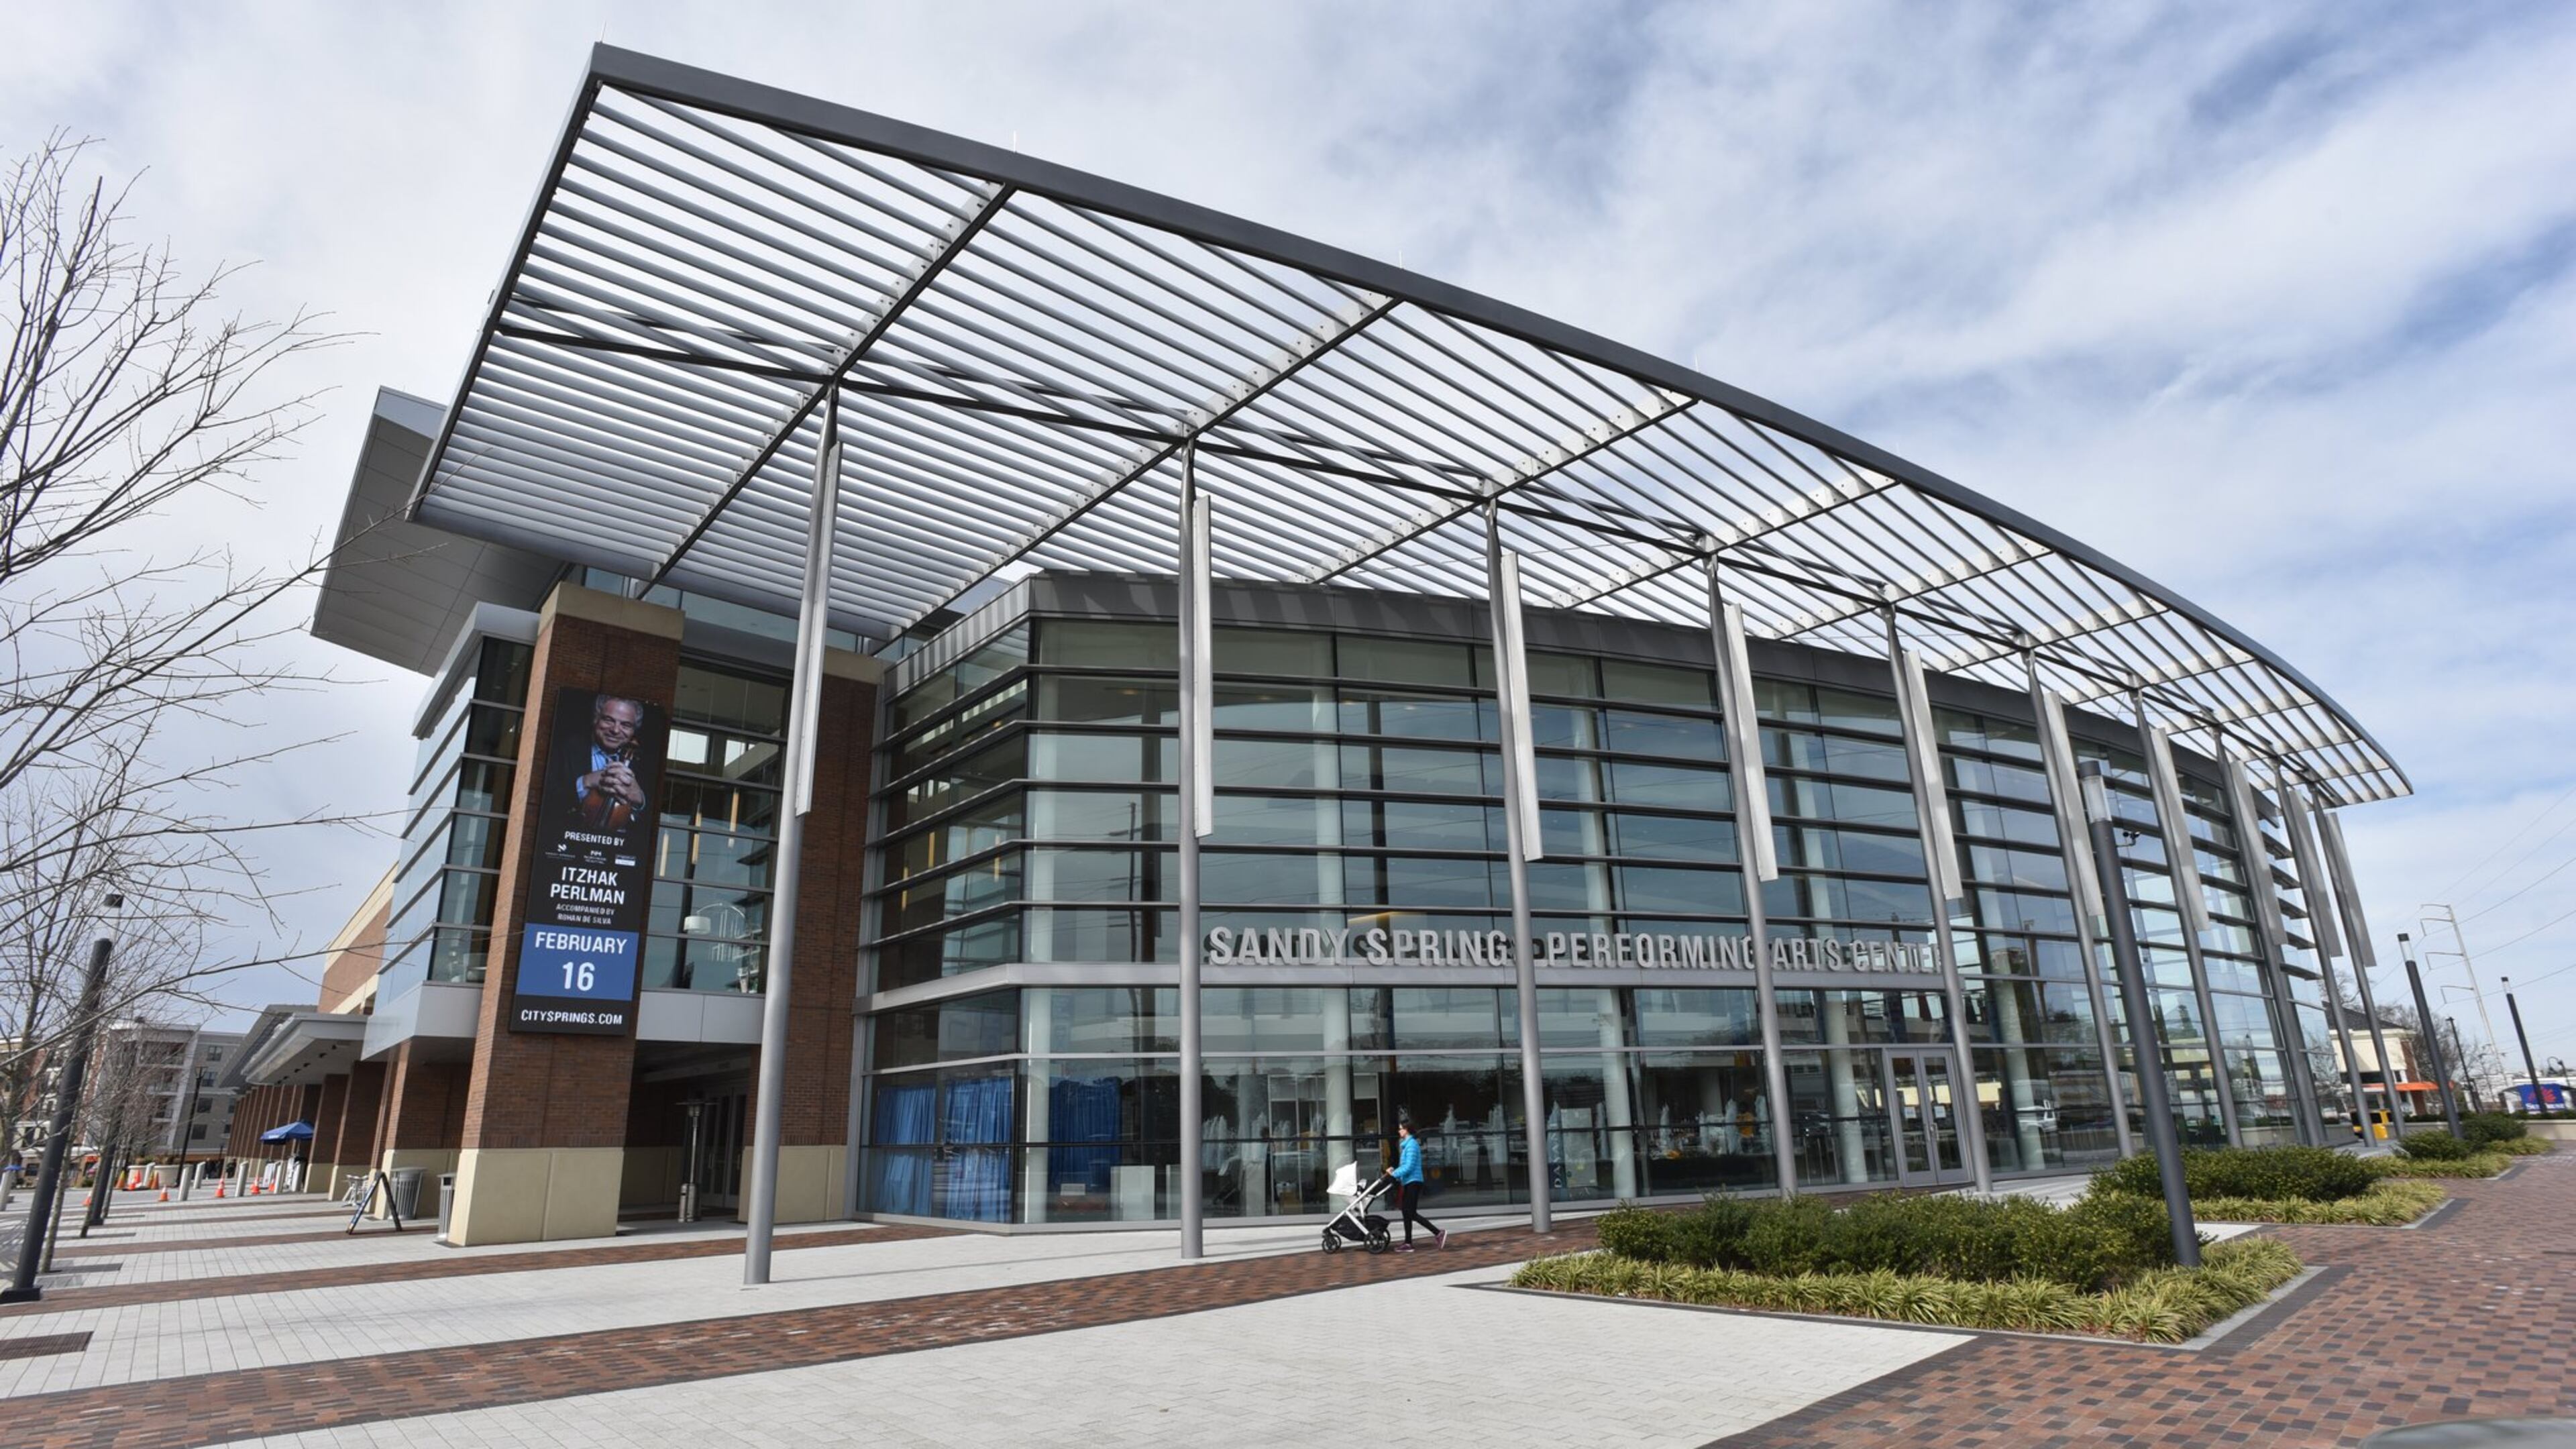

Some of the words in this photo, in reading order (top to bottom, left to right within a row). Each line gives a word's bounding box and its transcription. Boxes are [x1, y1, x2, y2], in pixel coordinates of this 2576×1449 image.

[564, 830, 612, 845] PRESENTED
[613, 837, 625, 847] BY
[561, 866, 618, 887] ITZHAK
[550, 883, 625, 905] PERLMAN
[555, 903, 606, 914] ACCOMPANIED
[557, 913, 582, 922] ROHAN
[592, 916, 612, 924] SILVA
[535, 932, 627, 954] FEBRUARY
[1210, 926, 1350, 965] SANDY
[1366, 928, 1515, 966] SPRING
[1547, 932, 1756, 969] PERFORMING
[1771, 937, 1842, 971] ARTS
[562, 961, 595, 991] 16
[521, 1009, 623, 1025] CITYSPRINGS.COM
